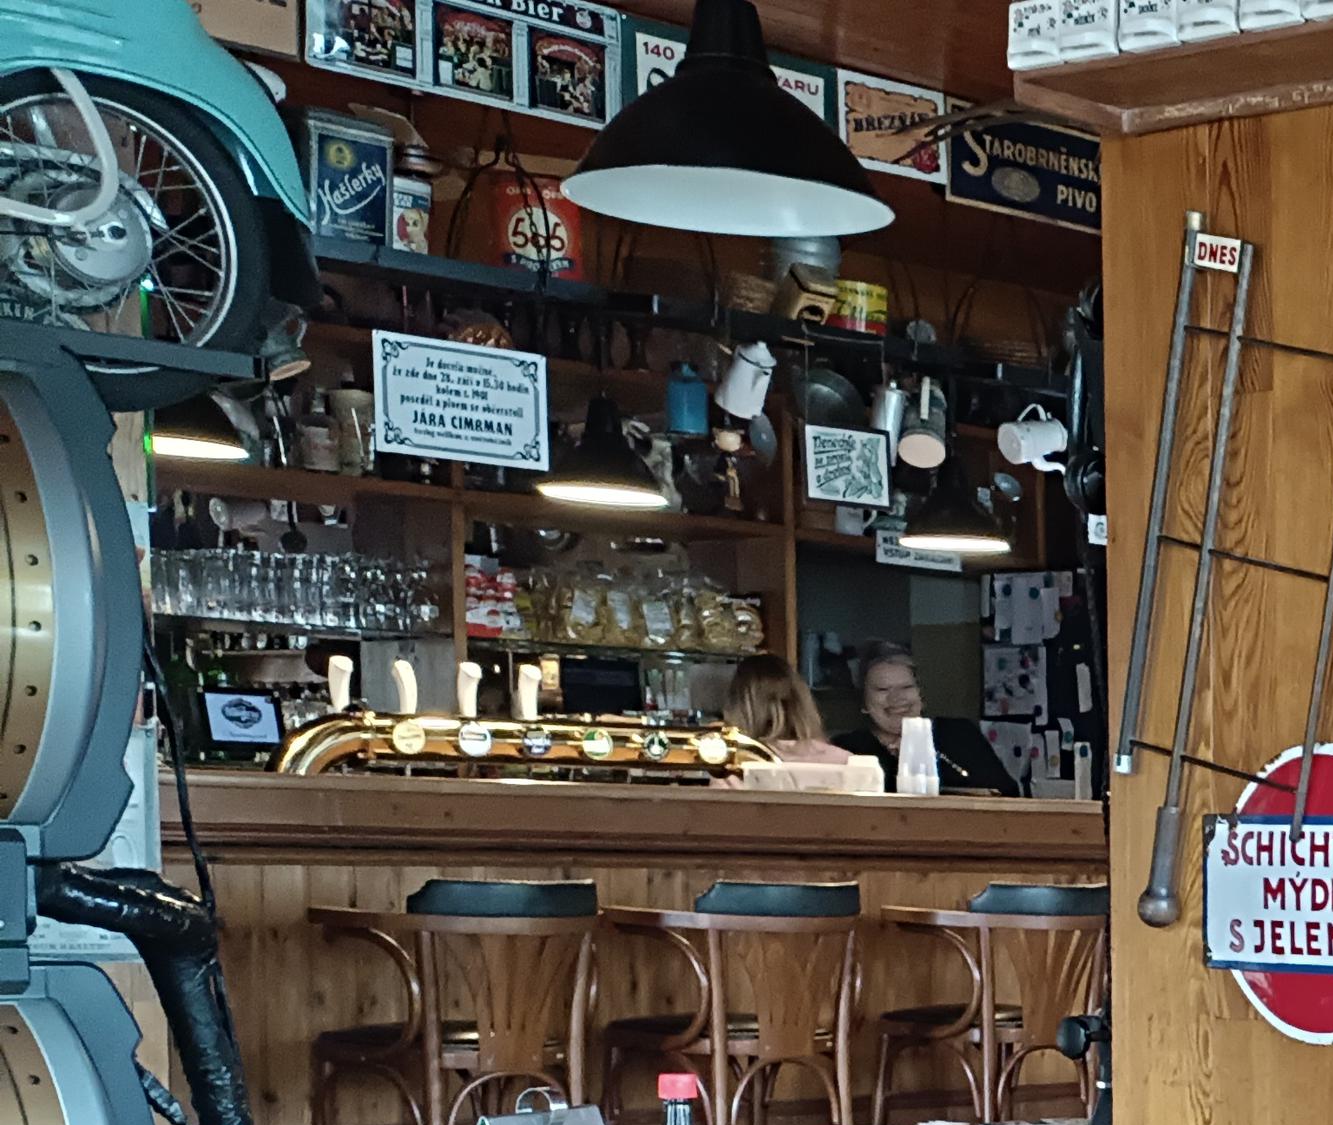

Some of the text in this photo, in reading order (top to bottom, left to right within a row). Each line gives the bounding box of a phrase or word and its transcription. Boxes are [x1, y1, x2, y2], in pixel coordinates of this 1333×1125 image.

[643, 41, 676, 61] 140
[962, 128, 1100, 186] STAROBRNĚNSK
[1056, 183, 1097, 213] PIVO
[1197, 241, 1237, 266] DNES
[412, 408, 446, 428] JÁRA
[451, 416, 513, 437] CIMRMAN
[1230, 919, 1245, 953] S
